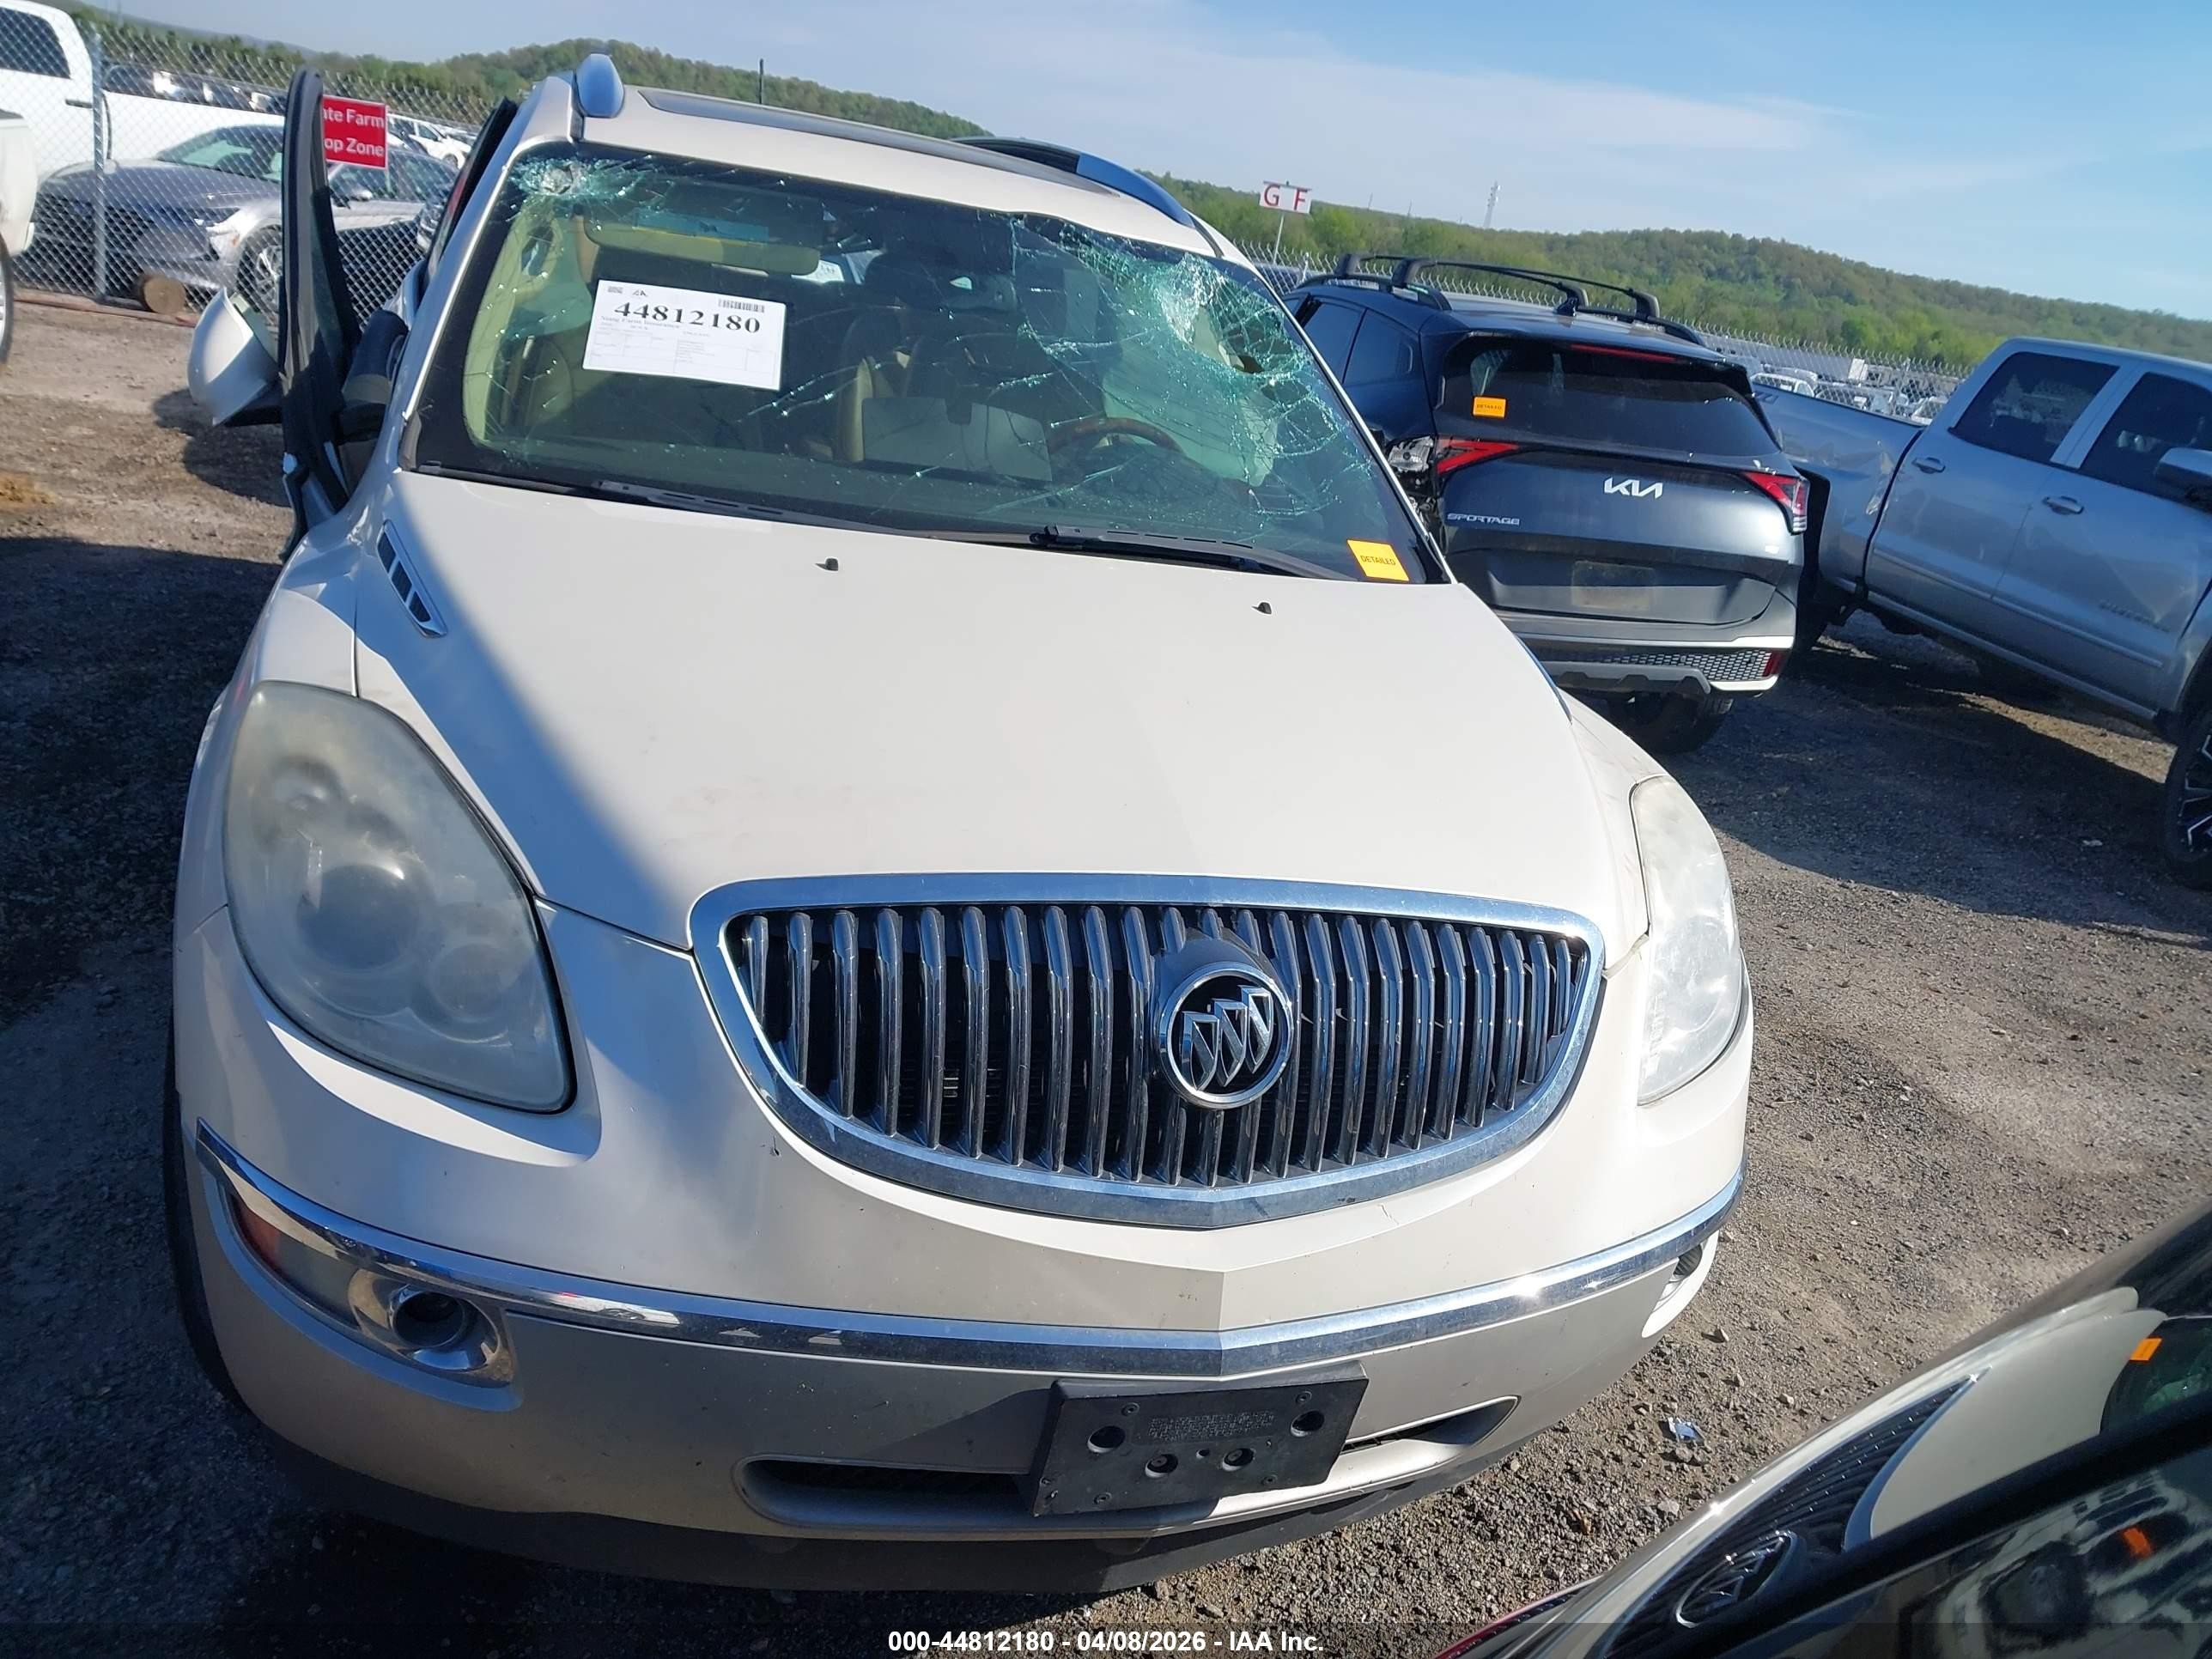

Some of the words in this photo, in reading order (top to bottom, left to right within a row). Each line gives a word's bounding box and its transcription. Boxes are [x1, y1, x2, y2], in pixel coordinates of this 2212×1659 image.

[346, 109, 384, 129] Farm
[346, 137, 384, 157] Zone
[1264, 184, 1280, 207] G
[1294, 188, 1309, 210] F
[614, 301, 761, 333] 44812180
[1446, 513, 1520, 526] SPORTAGE
[1359, 555, 1396, 566] DETAILED
